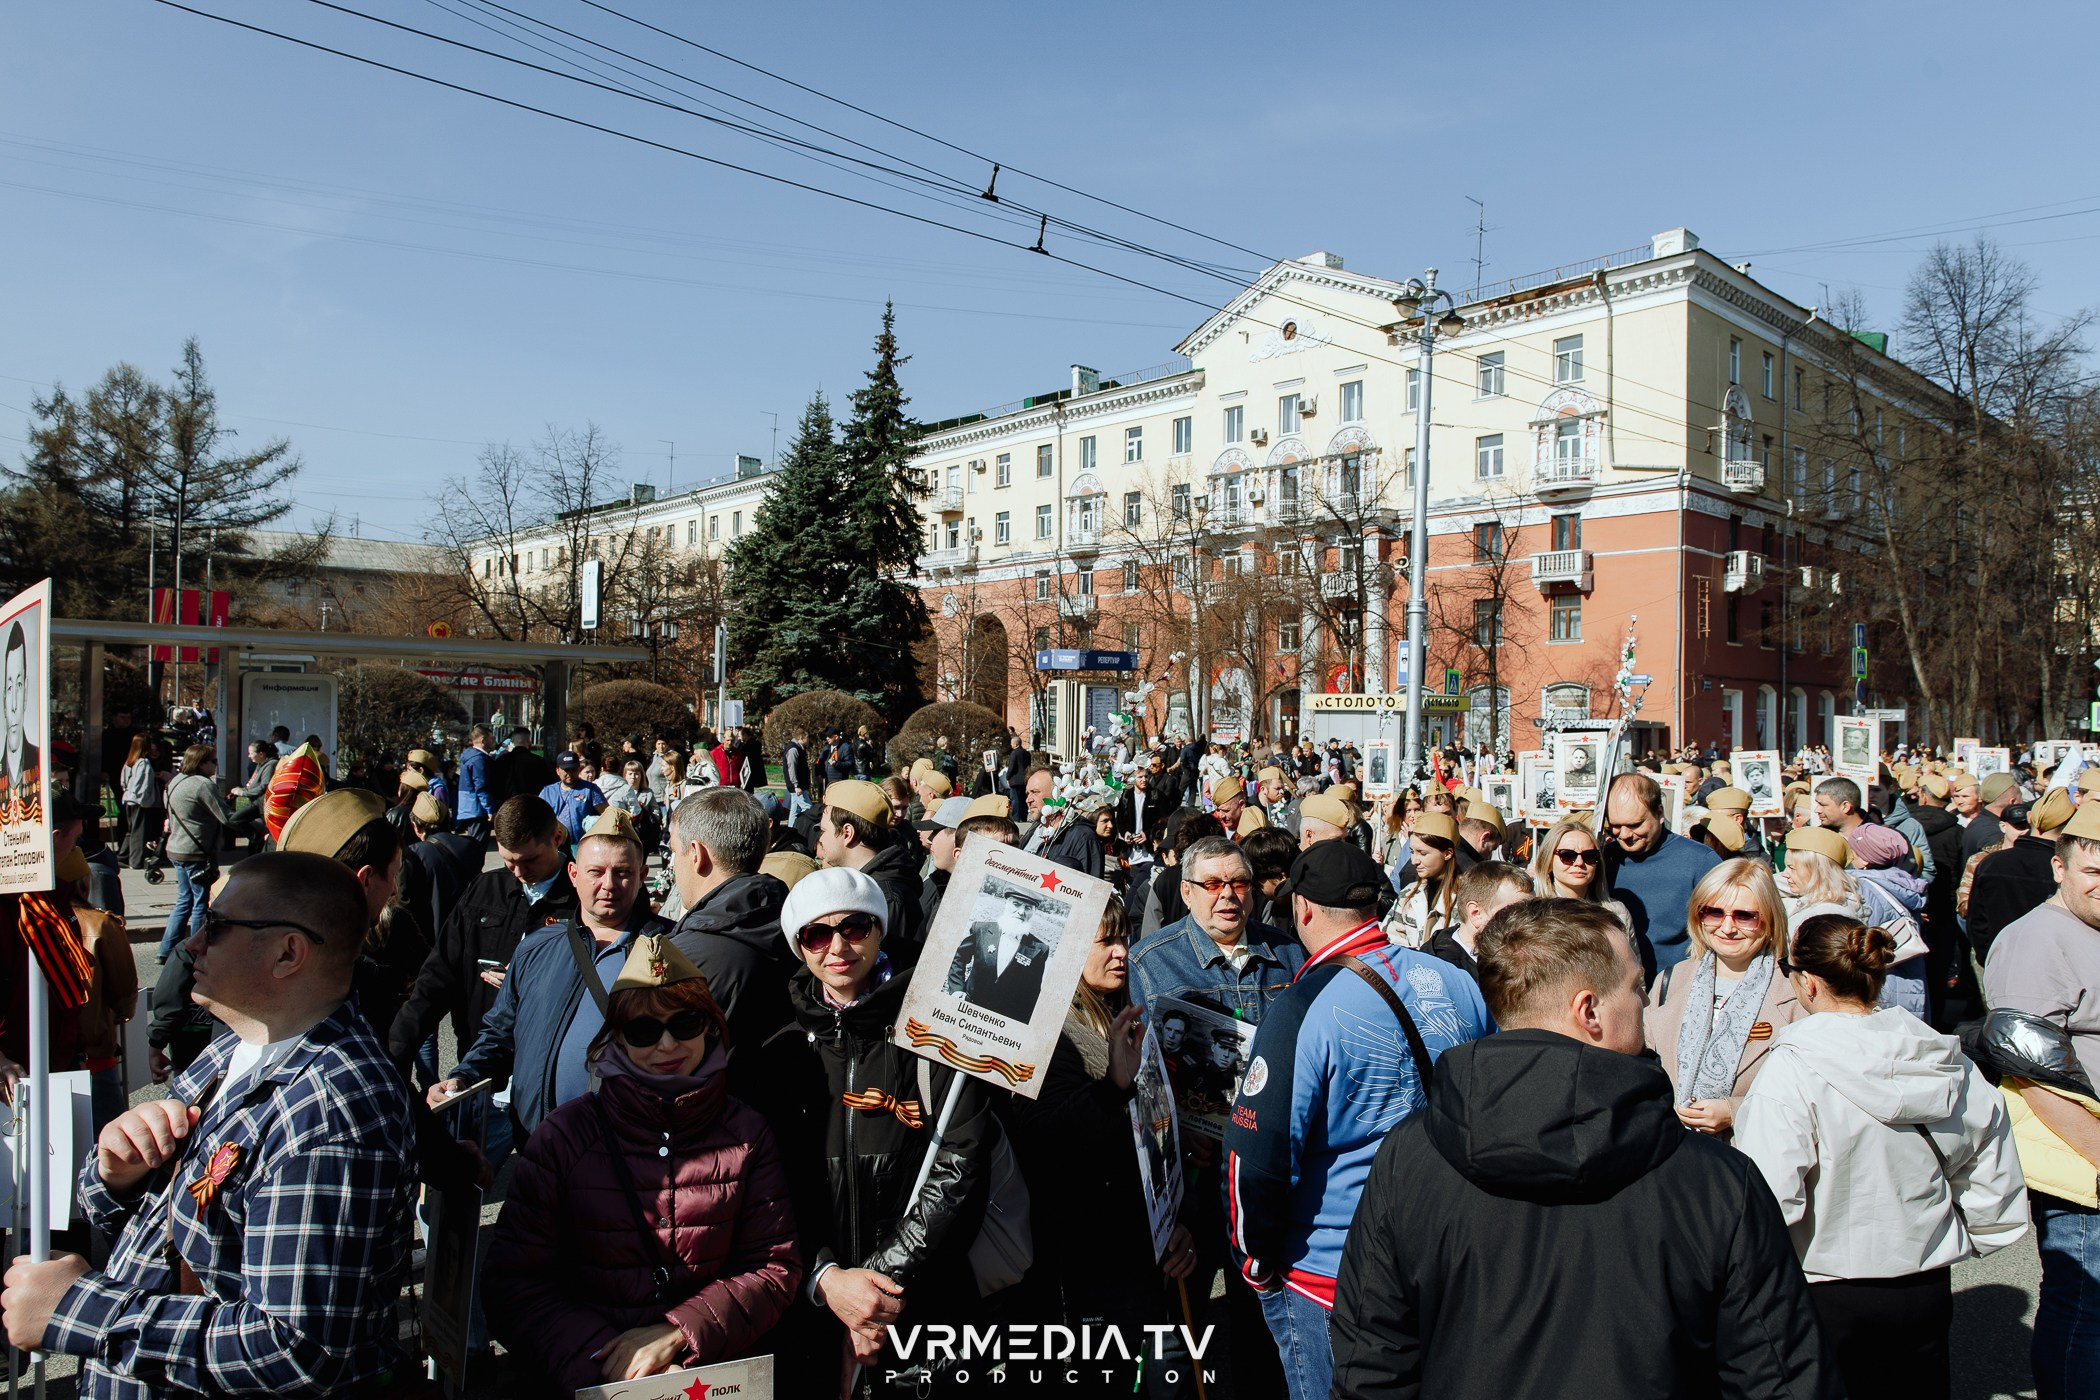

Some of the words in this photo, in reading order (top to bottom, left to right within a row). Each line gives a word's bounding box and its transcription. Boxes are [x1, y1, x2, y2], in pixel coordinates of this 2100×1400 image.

[262, 684, 320, 693] Информация
[3, 831, 31, 847] Стенькин
[13, 850, 45, 869] Егорович
[957, 1002, 1006, 1029] Шевченко
[932, 1008, 957, 1026] Иван
[958, 1018, 1022, 1050] Силантьевич
[962, 1034, 983, 1046] Рядовой
[1237, 1105, 1256, 1121] TEAM
[1231, 1113, 1258, 1132] RUSSIA
